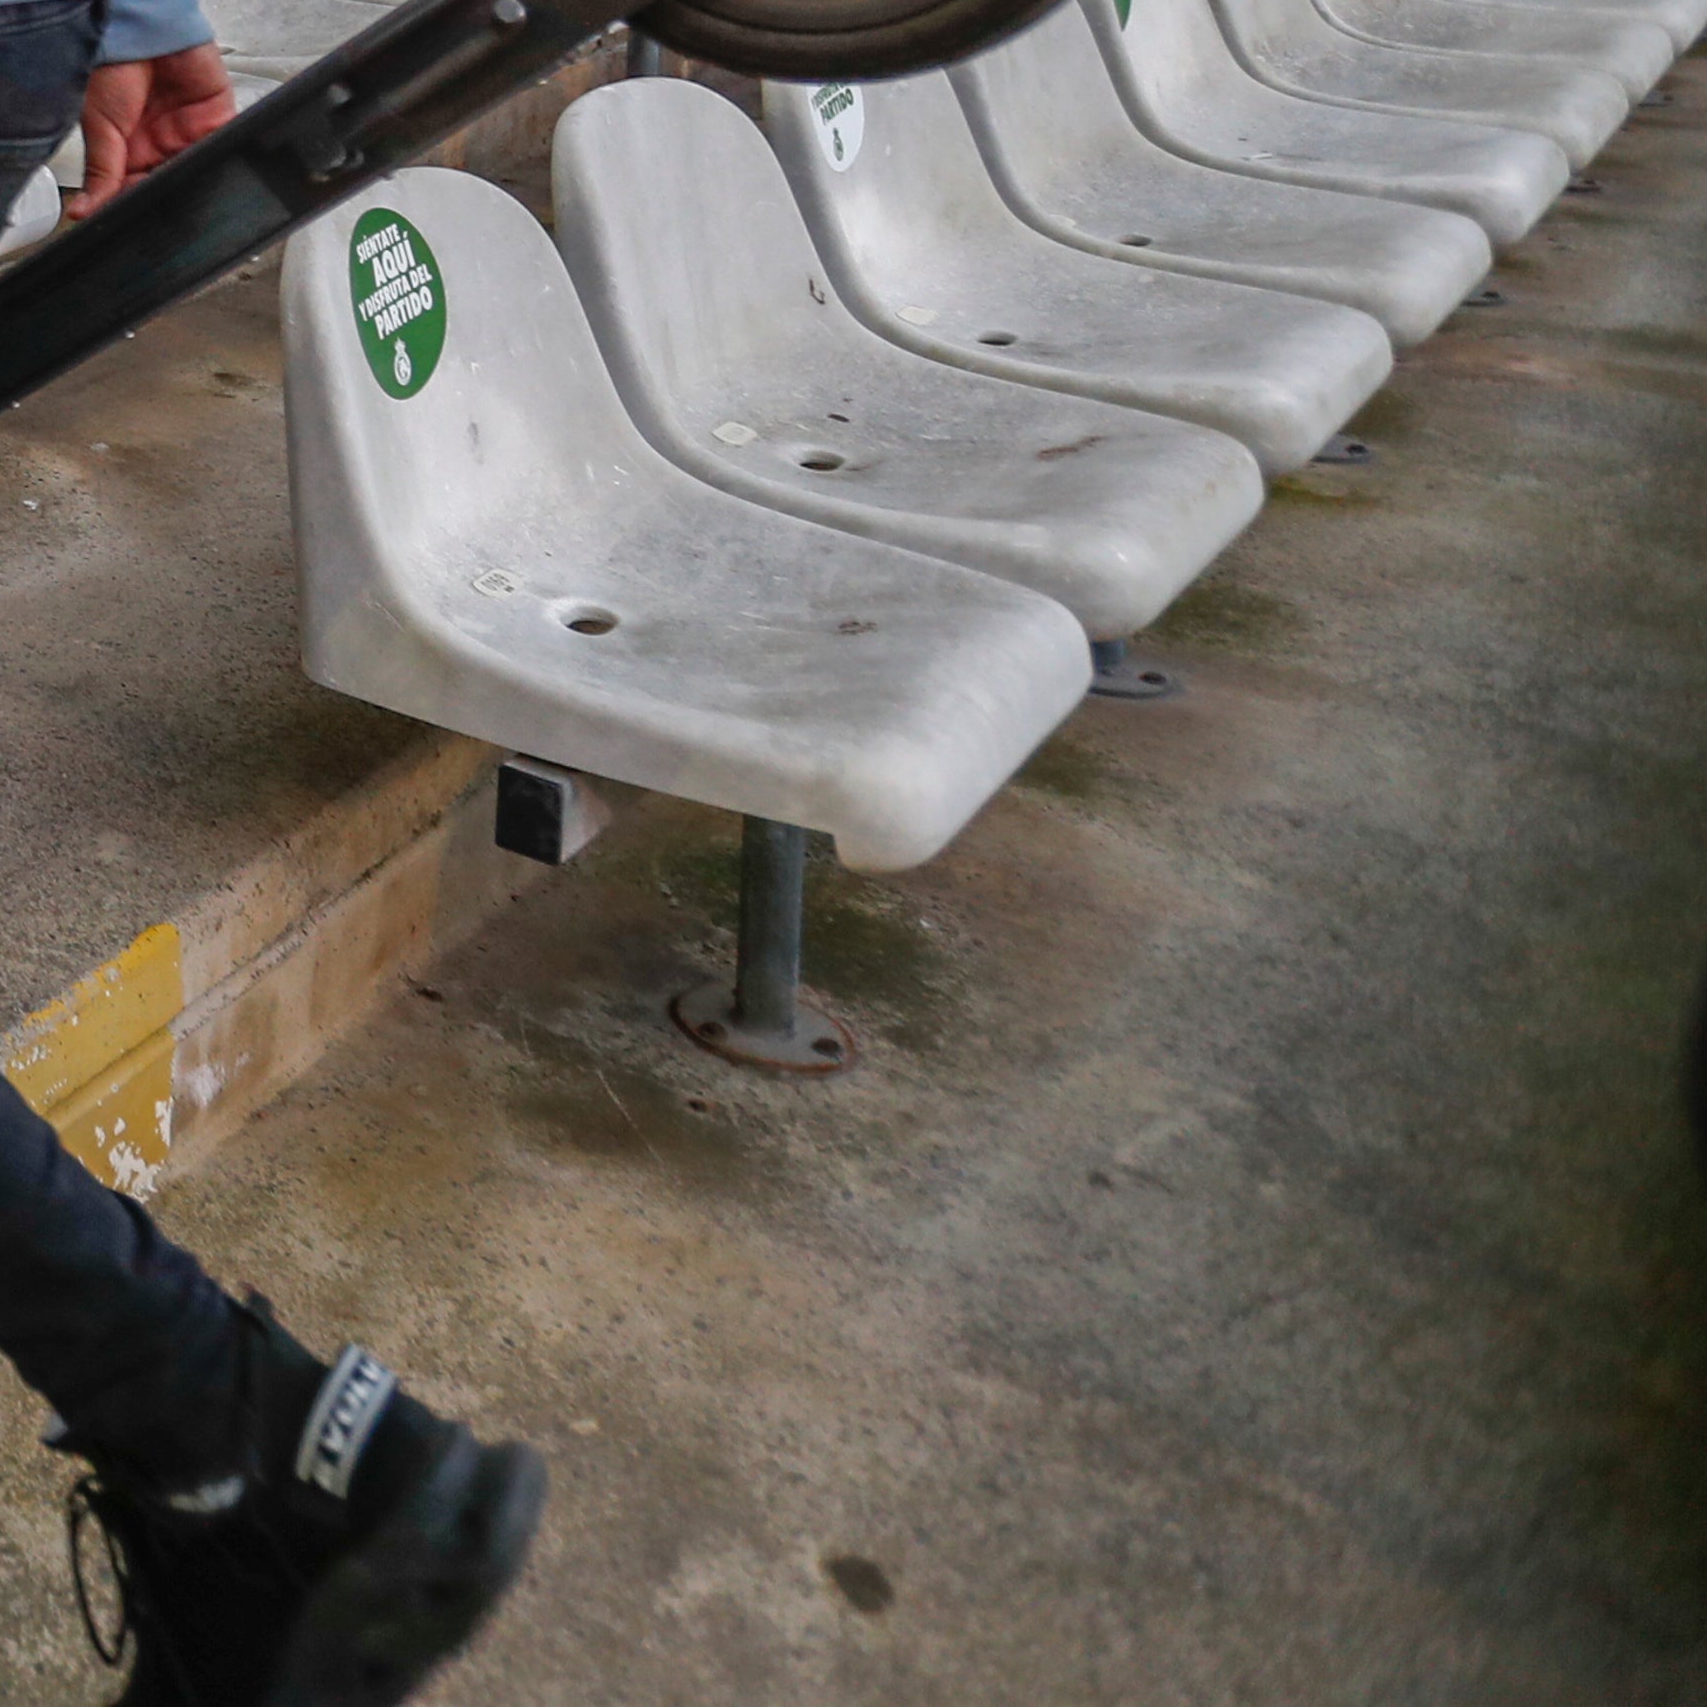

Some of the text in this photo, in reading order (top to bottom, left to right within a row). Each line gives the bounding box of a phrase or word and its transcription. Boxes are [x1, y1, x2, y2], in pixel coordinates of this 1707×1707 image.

[356, 223, 401, 264] SIÉNTATE
[371, 230, 415, 287] AQUÍ
[358, 263, 433, 322] Y DISFRUTA DEL
[373, 286, 434, 341] PARTIDO
